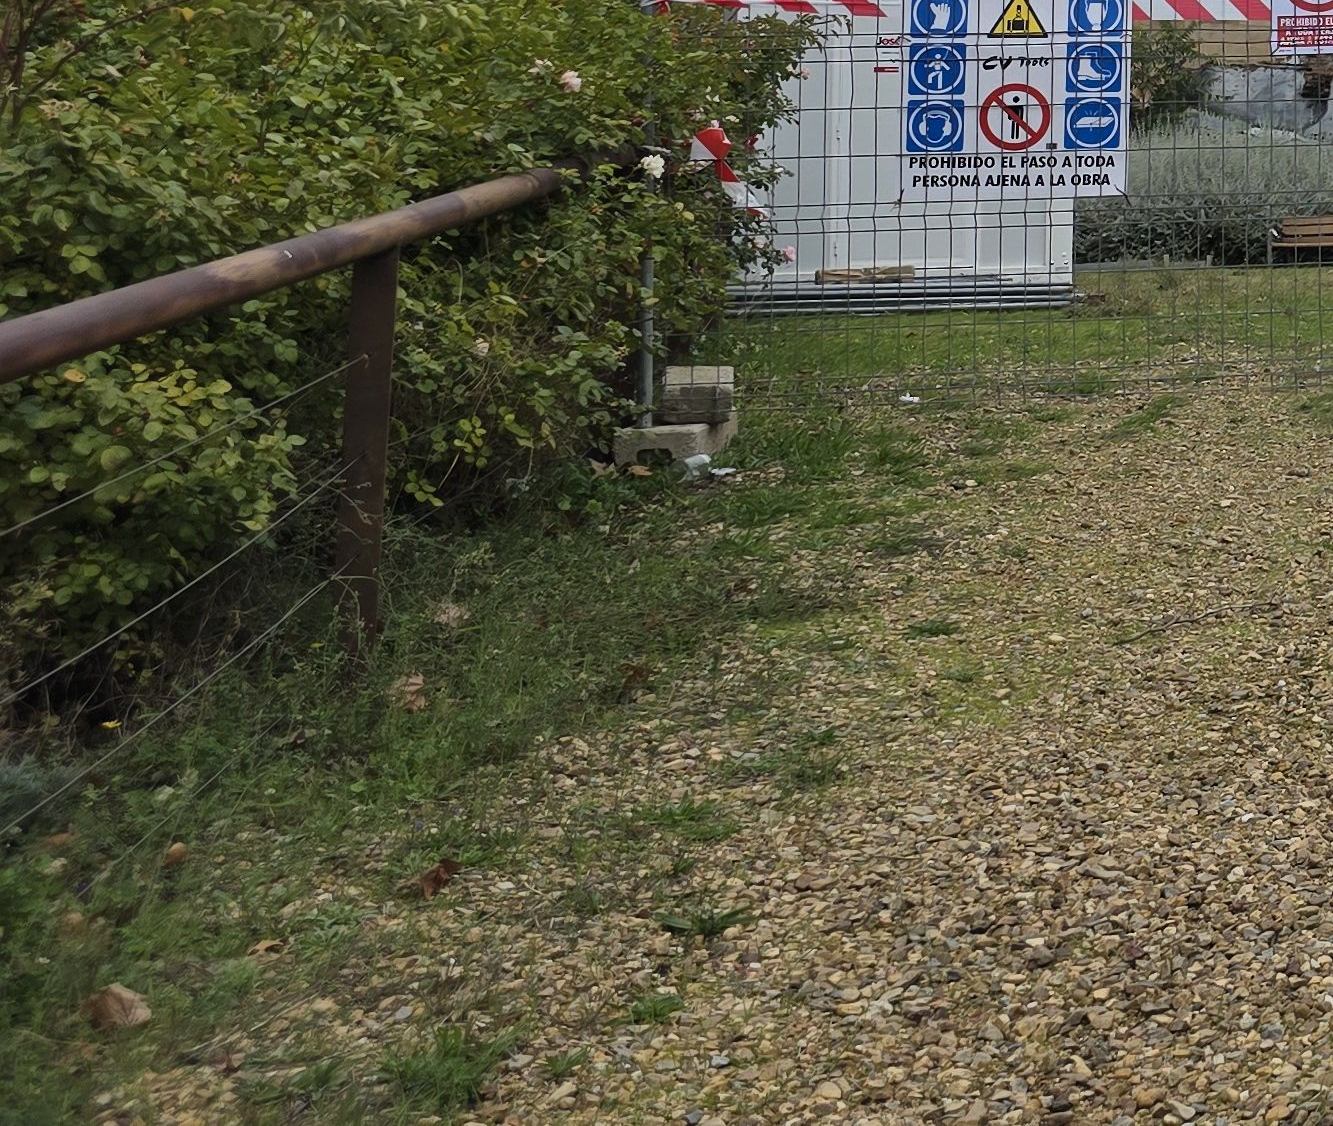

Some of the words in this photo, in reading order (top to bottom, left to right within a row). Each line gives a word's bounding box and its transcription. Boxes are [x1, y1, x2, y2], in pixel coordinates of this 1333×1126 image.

[1280, 17, 1323, 27] PROHIBIDO
[1017, 56, 1050, 68] Tools
[909, 156, 995, 169] PROHIBIDO
[1001, 156, 1016, 168] EL
[1020, 155, 1058, 168] PASO
[1061, 155, 1072, 168] A
[1076, 155, 1115, 168] TODA
[912, 174, 981, 187] PERSONA
[985, 174, 1030, 187] AJENA
[1034, 174, 1045, 186] A
[1050, 174, 1066, 186] LA
[1070, 173, 1110, 186] OBRA
